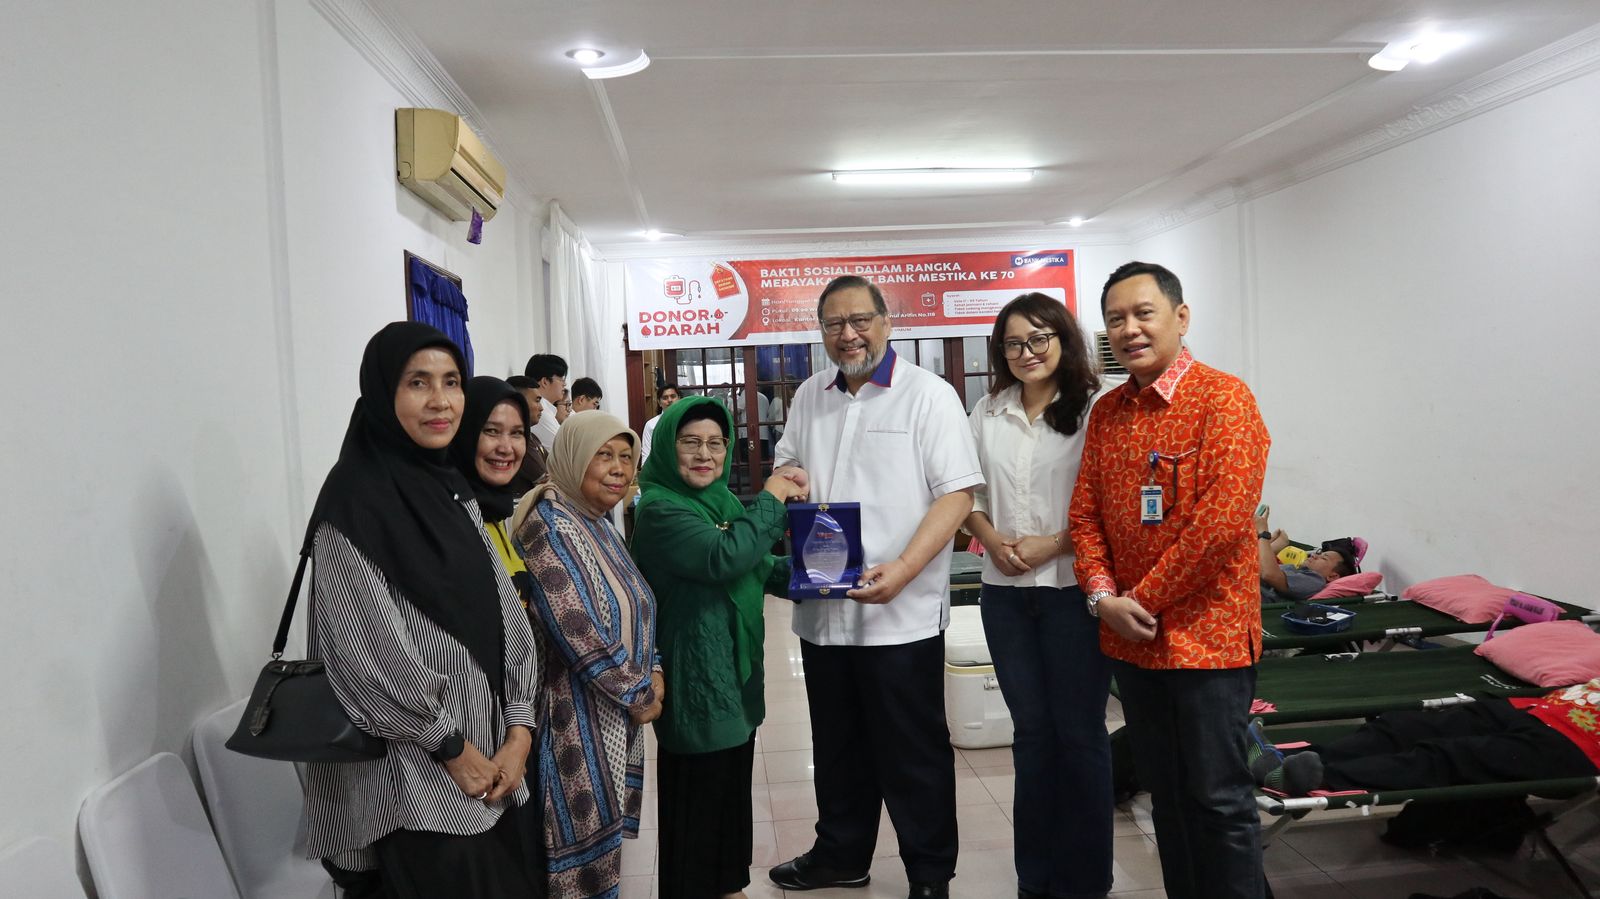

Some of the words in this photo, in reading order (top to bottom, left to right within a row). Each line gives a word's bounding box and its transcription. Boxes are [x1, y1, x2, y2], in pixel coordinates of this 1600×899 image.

[760, 268, 800, 278] BAKTI
[804, 265, 852, 276] SOSIAL
[855, 264, 902, 274] DALAM
[906, 262, 961, 272] RANGKA
[761, 277, 838, 288] MERAYAKA
[878, 274, 915, 284] BANK
[918, 271, 977, 282] MESTIKA
[980, 271, 998, 280] KE
[1001, 271, 1015, 279] 70
[639, 309, 709, 323] DONOR
[654, 322, 720, 336] DARAH
